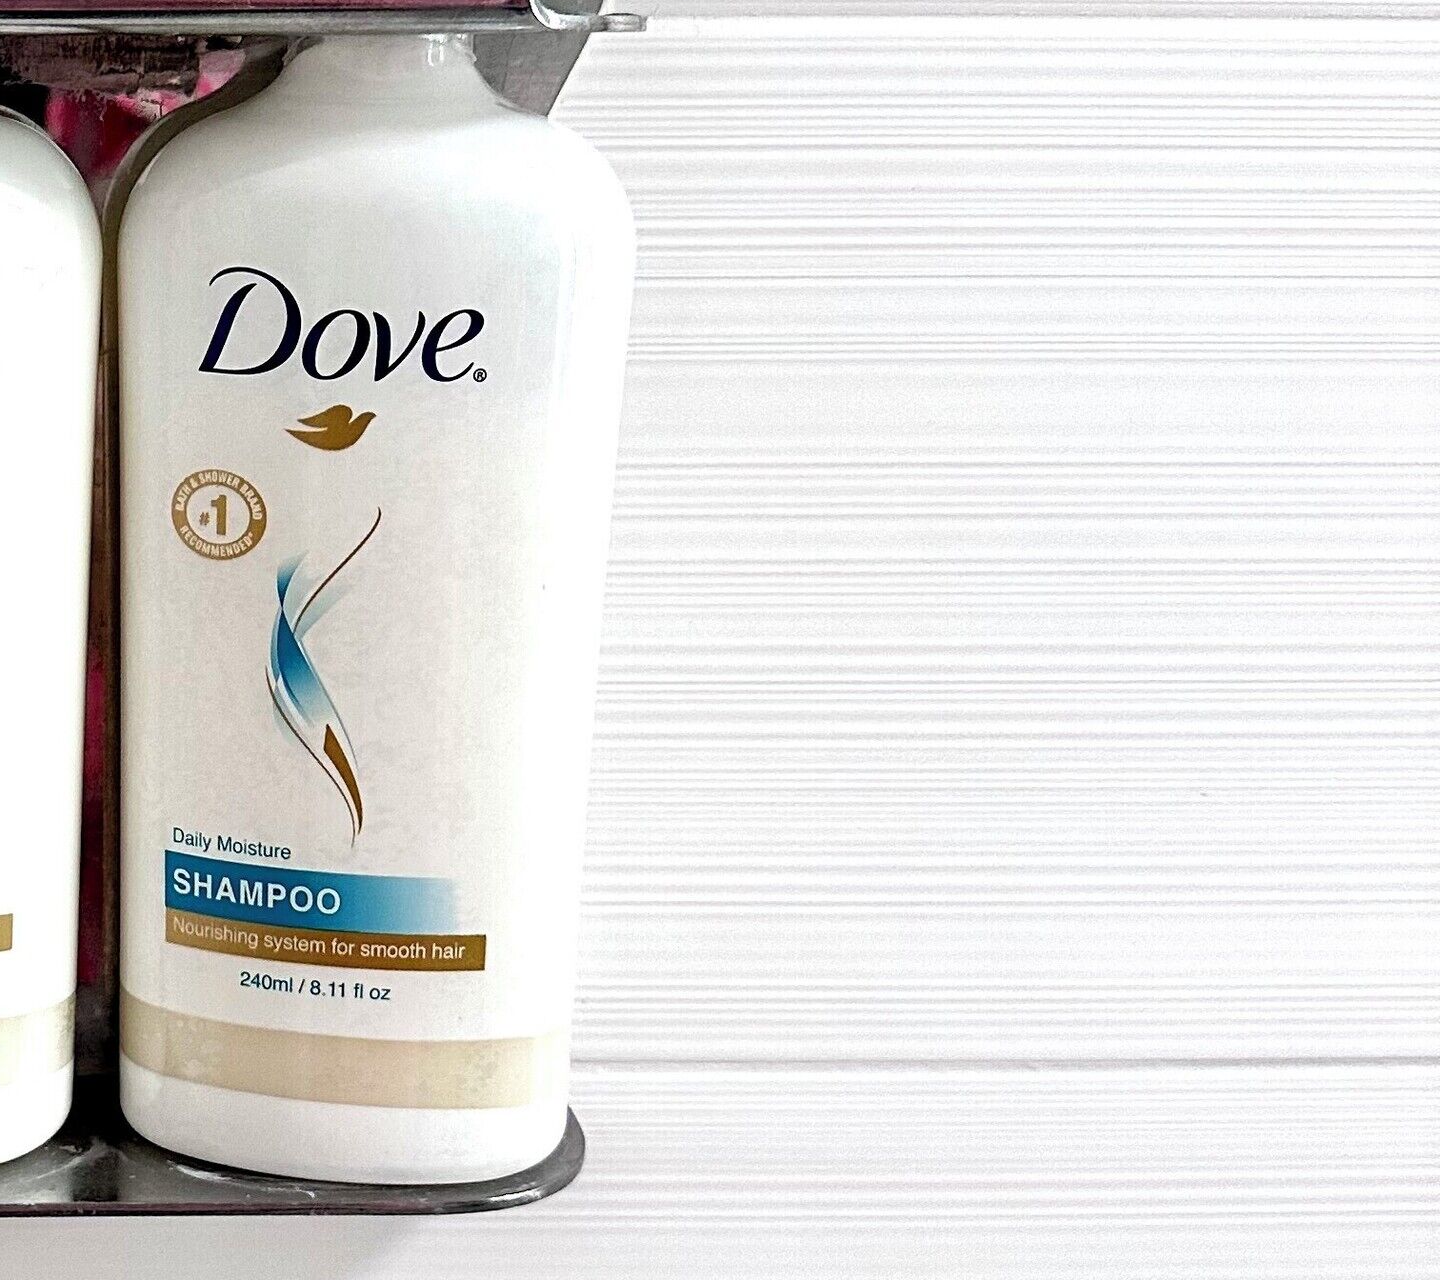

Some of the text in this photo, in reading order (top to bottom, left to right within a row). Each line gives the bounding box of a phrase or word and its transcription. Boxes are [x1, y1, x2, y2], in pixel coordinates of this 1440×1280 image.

[198, 494, 227, 536] #1
[172, 827, 291, 860] Daily Moisture
[172, 868, 342, 915] SHAMPOO
[173, 916, 465, 960] Nourishing system for smooth hair
[240, 971, 391, 1001] 240ml / 8.11 fl oz
